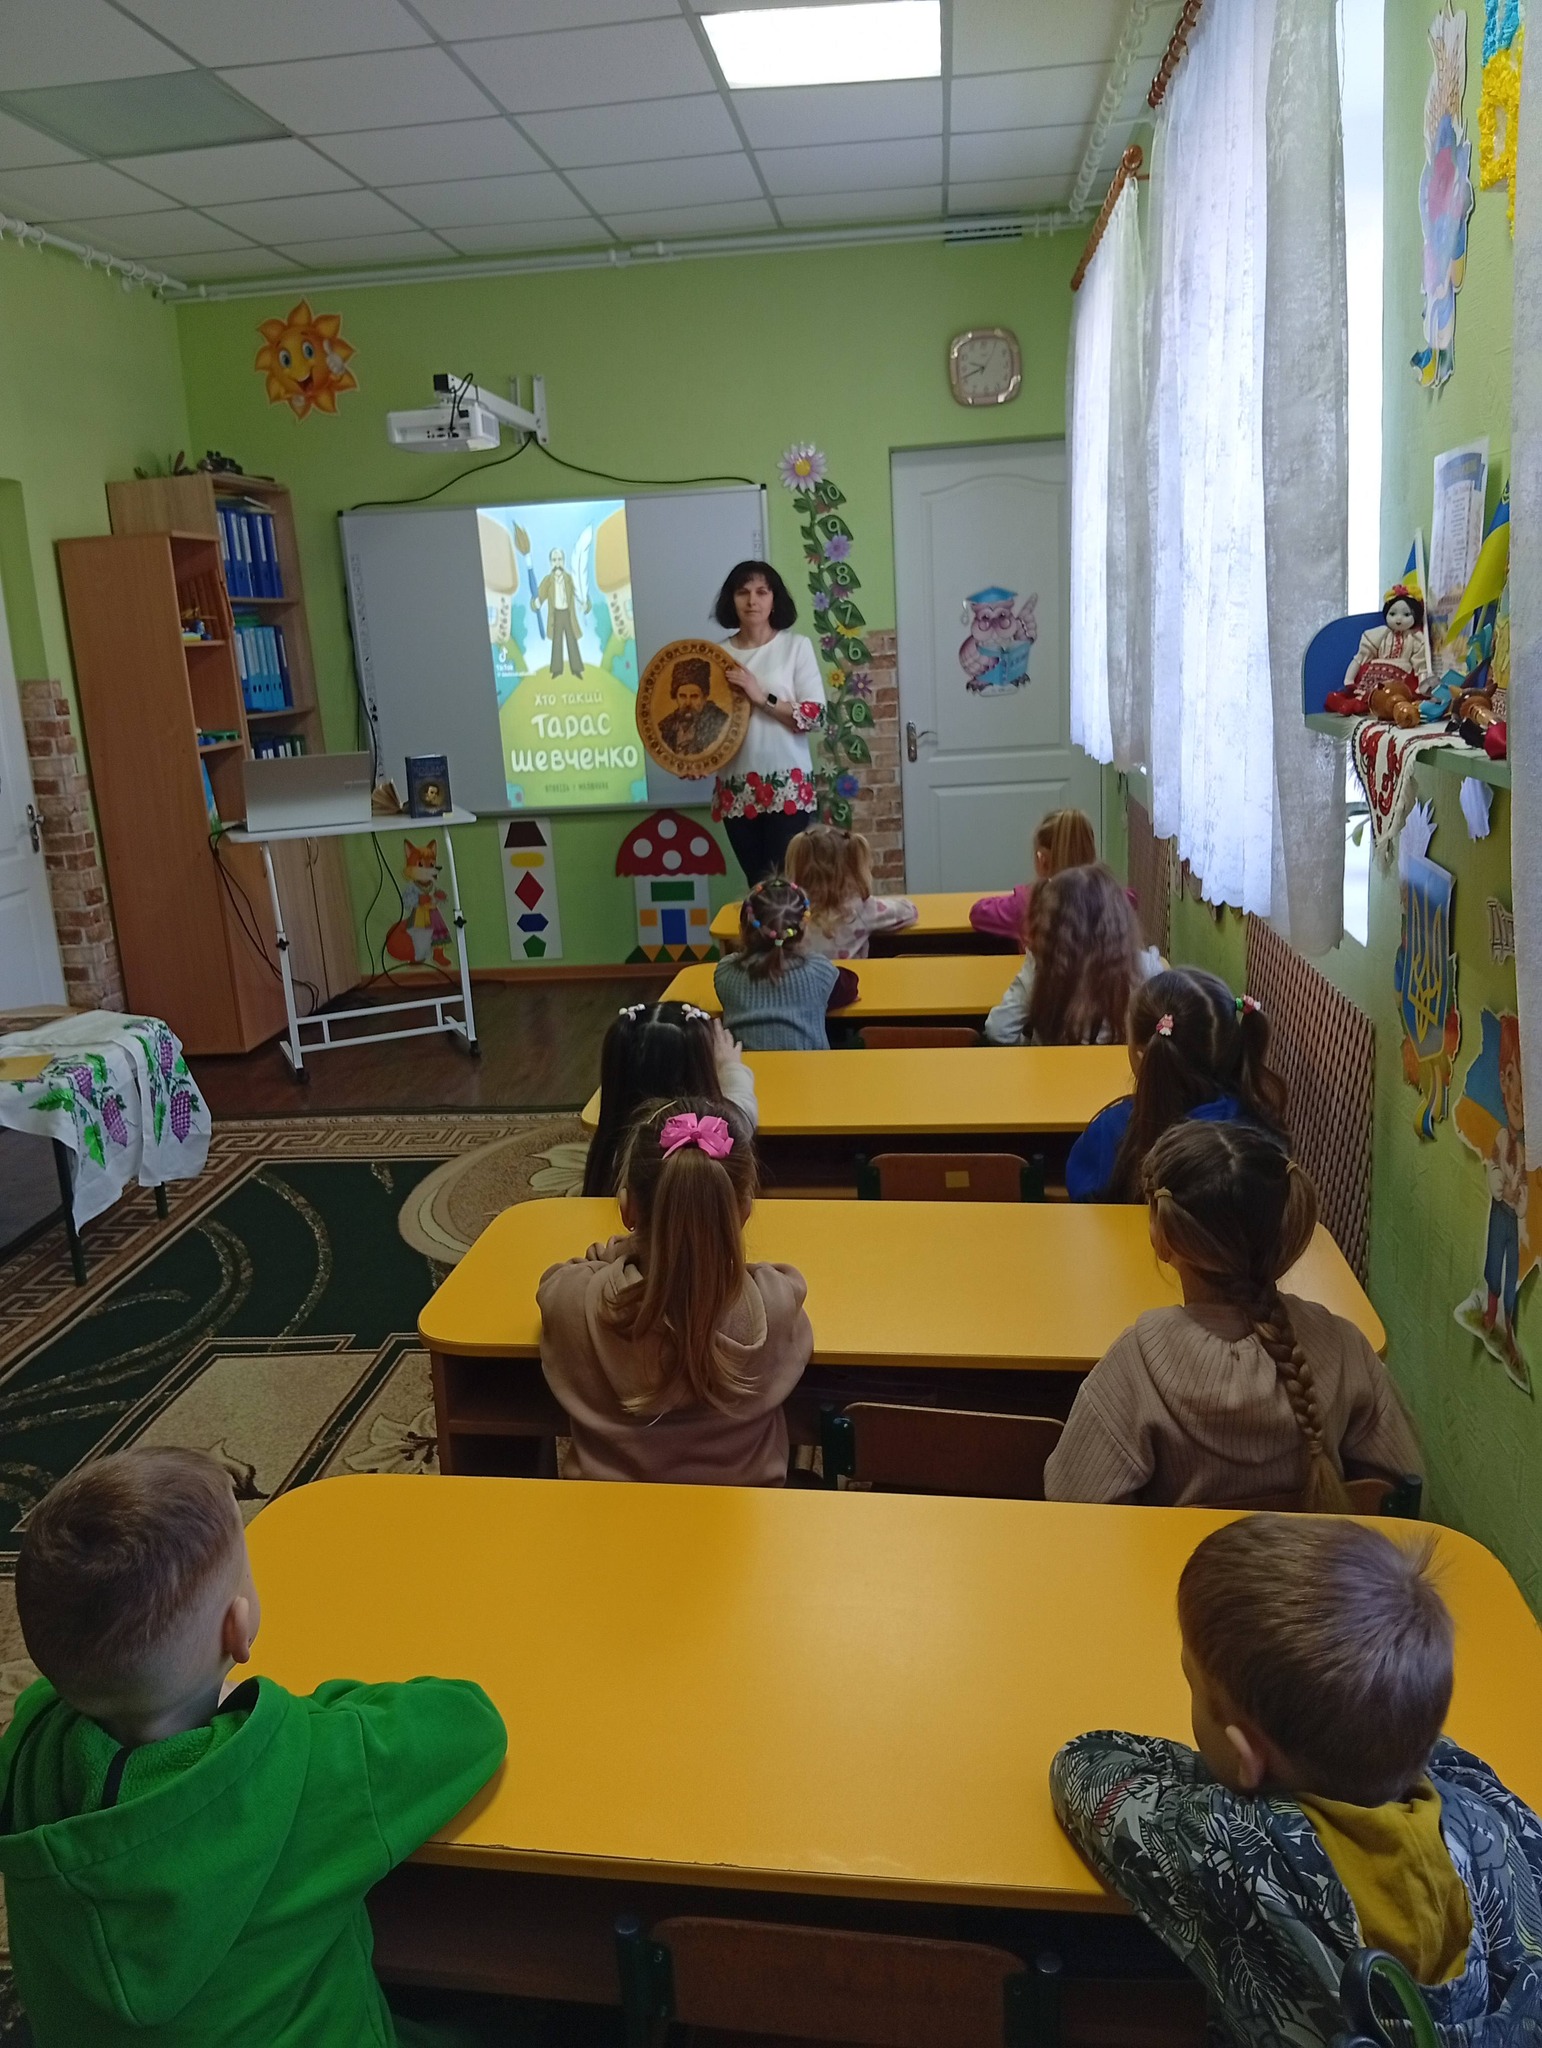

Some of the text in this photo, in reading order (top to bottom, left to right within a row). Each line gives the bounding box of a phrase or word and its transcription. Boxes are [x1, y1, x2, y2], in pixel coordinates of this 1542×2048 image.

[818, 484, 840, 505] 10
[827, 519, 842, 536] 9
[836, 565, 850, 585] 8
[840, 604, 852, 625] 7
[848, 642, 862, 660] 6
[850, 740, 863, 759] 4
[834, 803, 849, 822] 3
